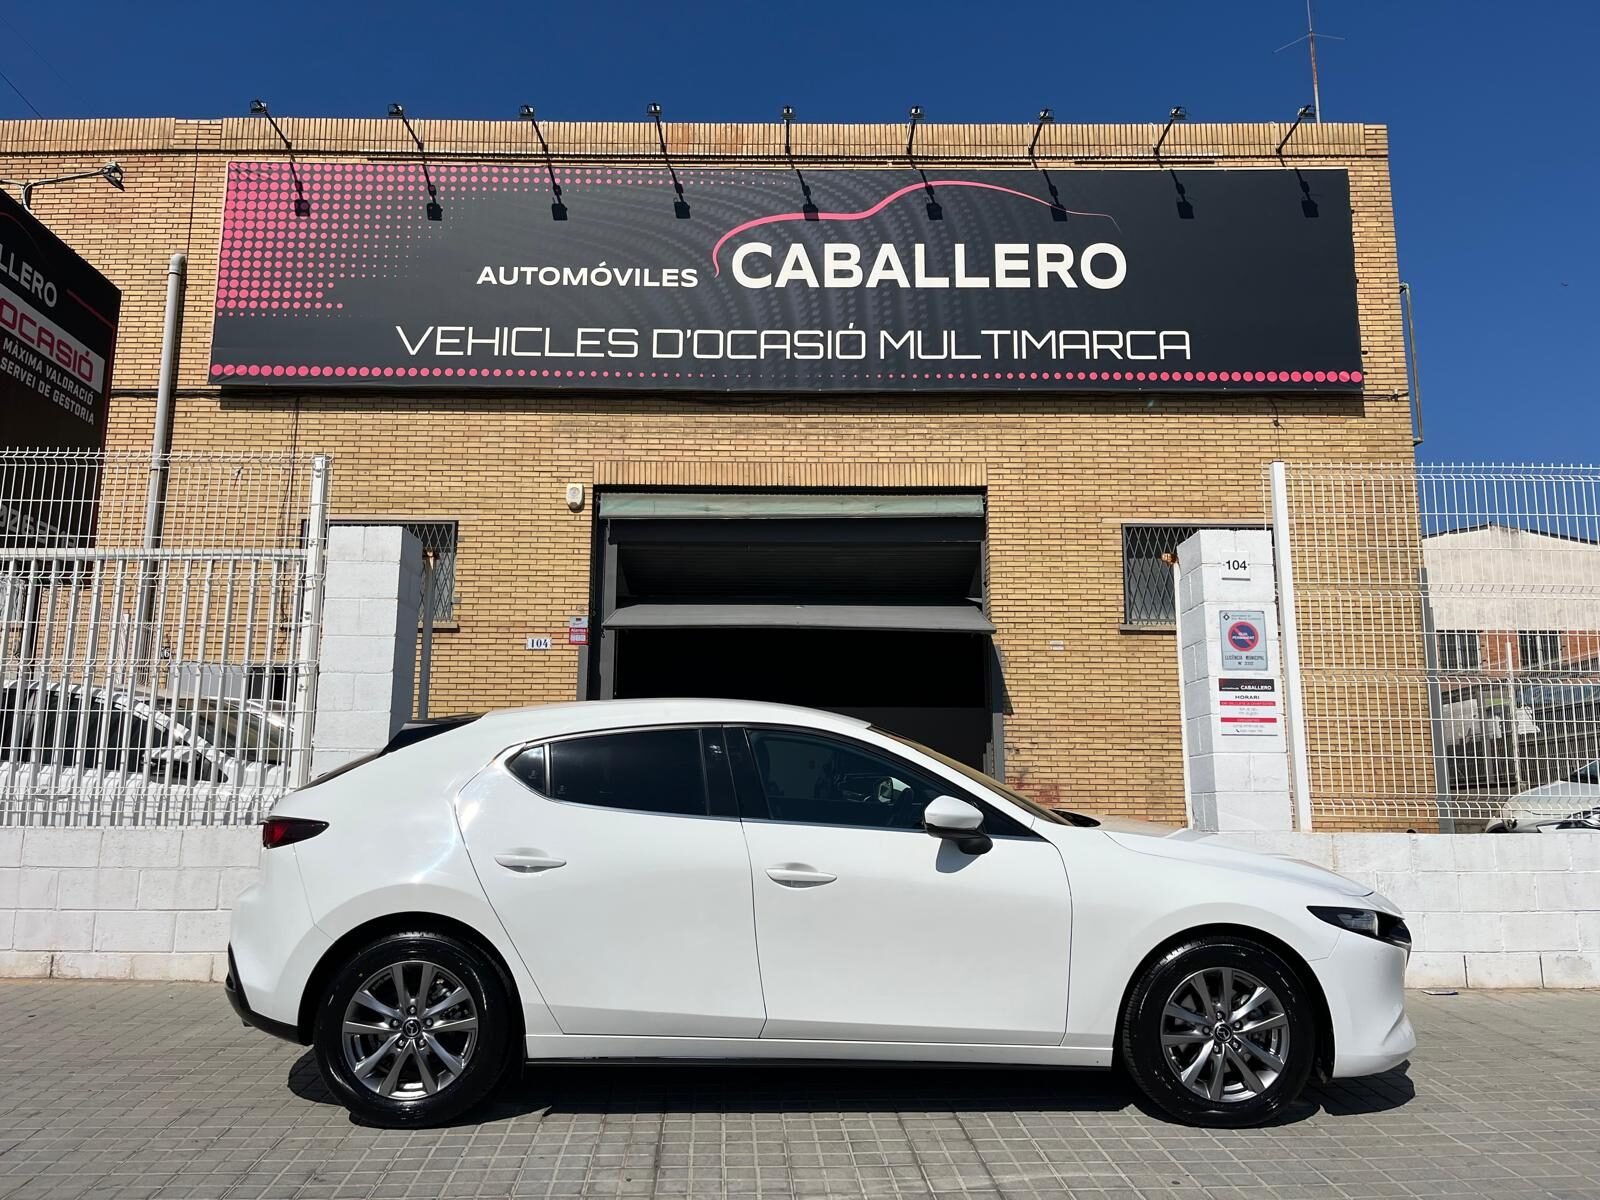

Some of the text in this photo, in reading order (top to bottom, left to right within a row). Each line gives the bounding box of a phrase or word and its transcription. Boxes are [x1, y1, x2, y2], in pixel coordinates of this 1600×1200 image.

[476, 242, 1127, 290] AUTOMÓVILES CABALLERO
[395, 322, 1192, 360] VEHICLES D'OCASIÓ MULTIMARCA
[0, 357, 95, 425] SERVEI DE GESTORIA
[45, 364, 94, 405] VALORACIÓ
[1225, 559, 1248, 571] 104
[531, 639, 548, 648] 104
